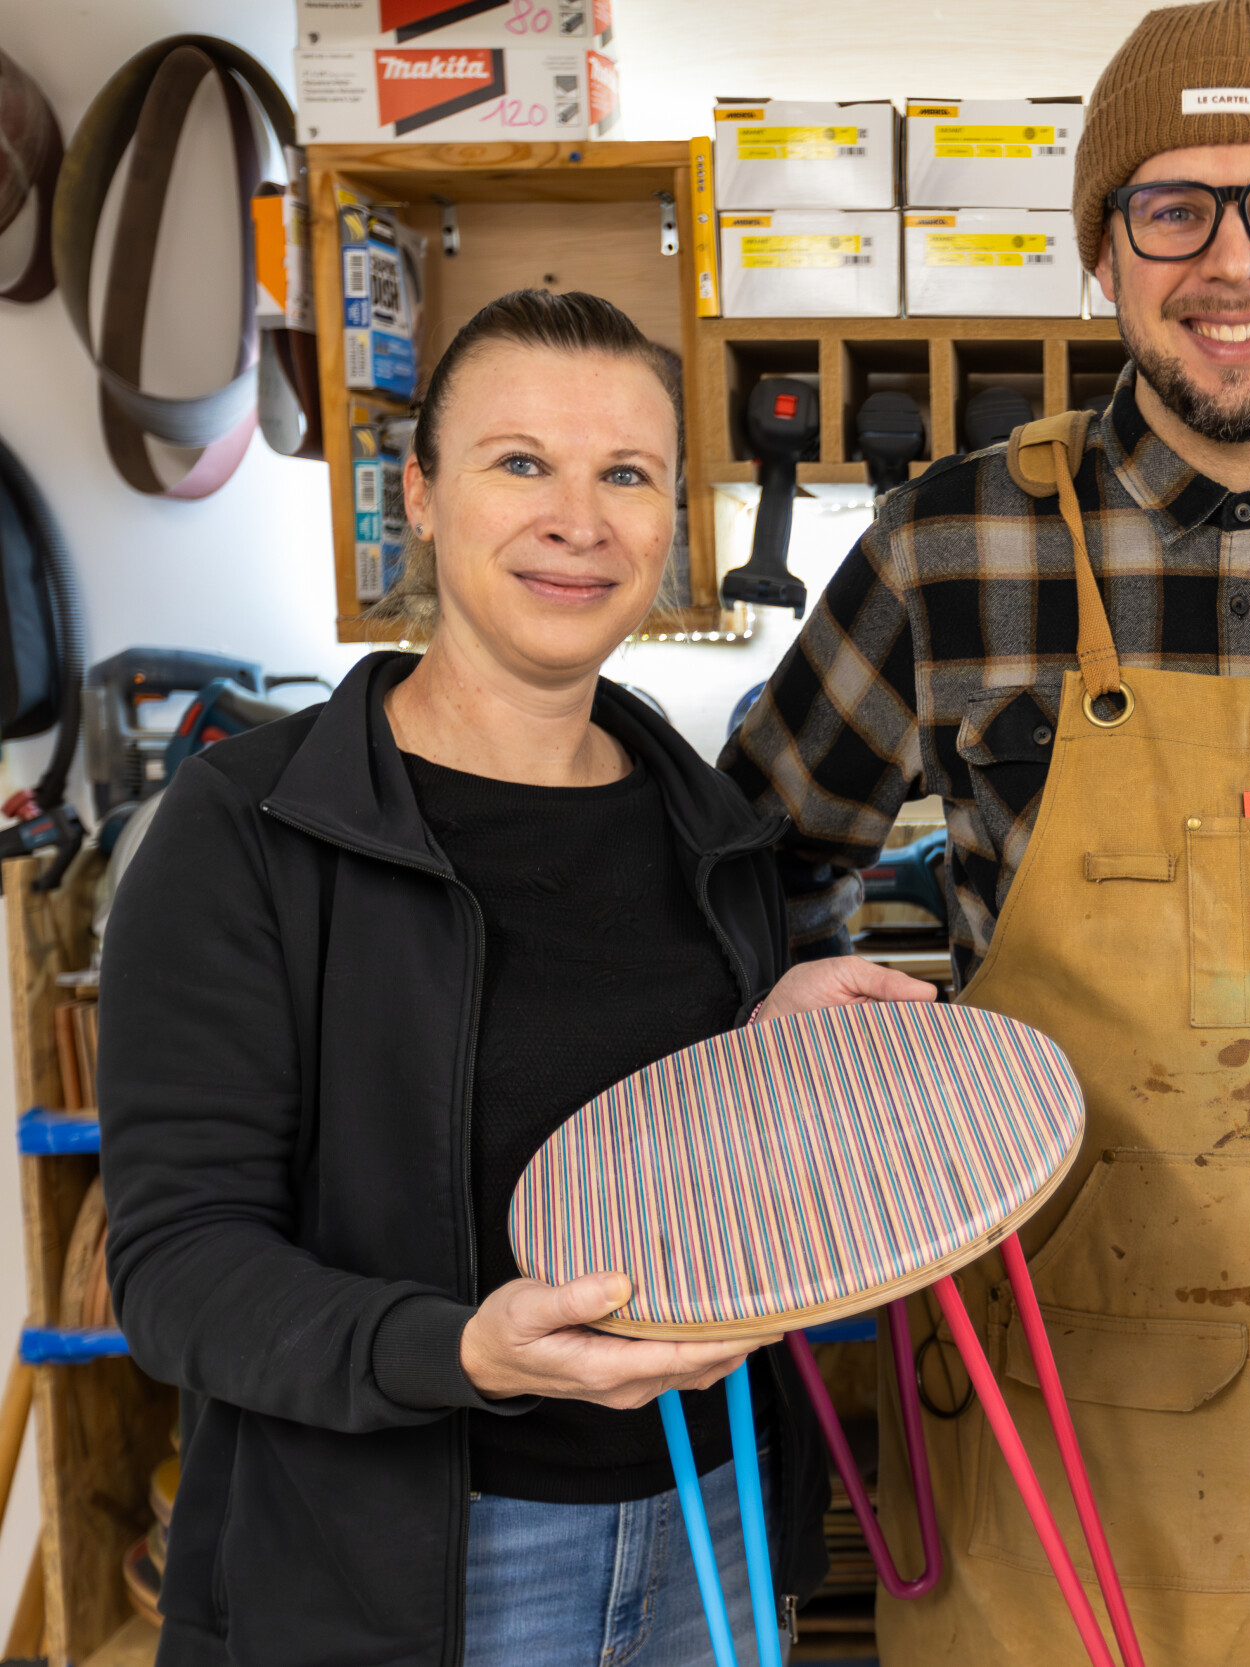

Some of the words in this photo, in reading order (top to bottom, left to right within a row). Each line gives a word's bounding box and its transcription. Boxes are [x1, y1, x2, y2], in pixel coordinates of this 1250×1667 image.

[378, 56, 490, 80] Makita
[1198, 96, 1208, 104] LE
[1212, 95, 1250, 104] CARTEL
[480, 100, 549, 126] 120
